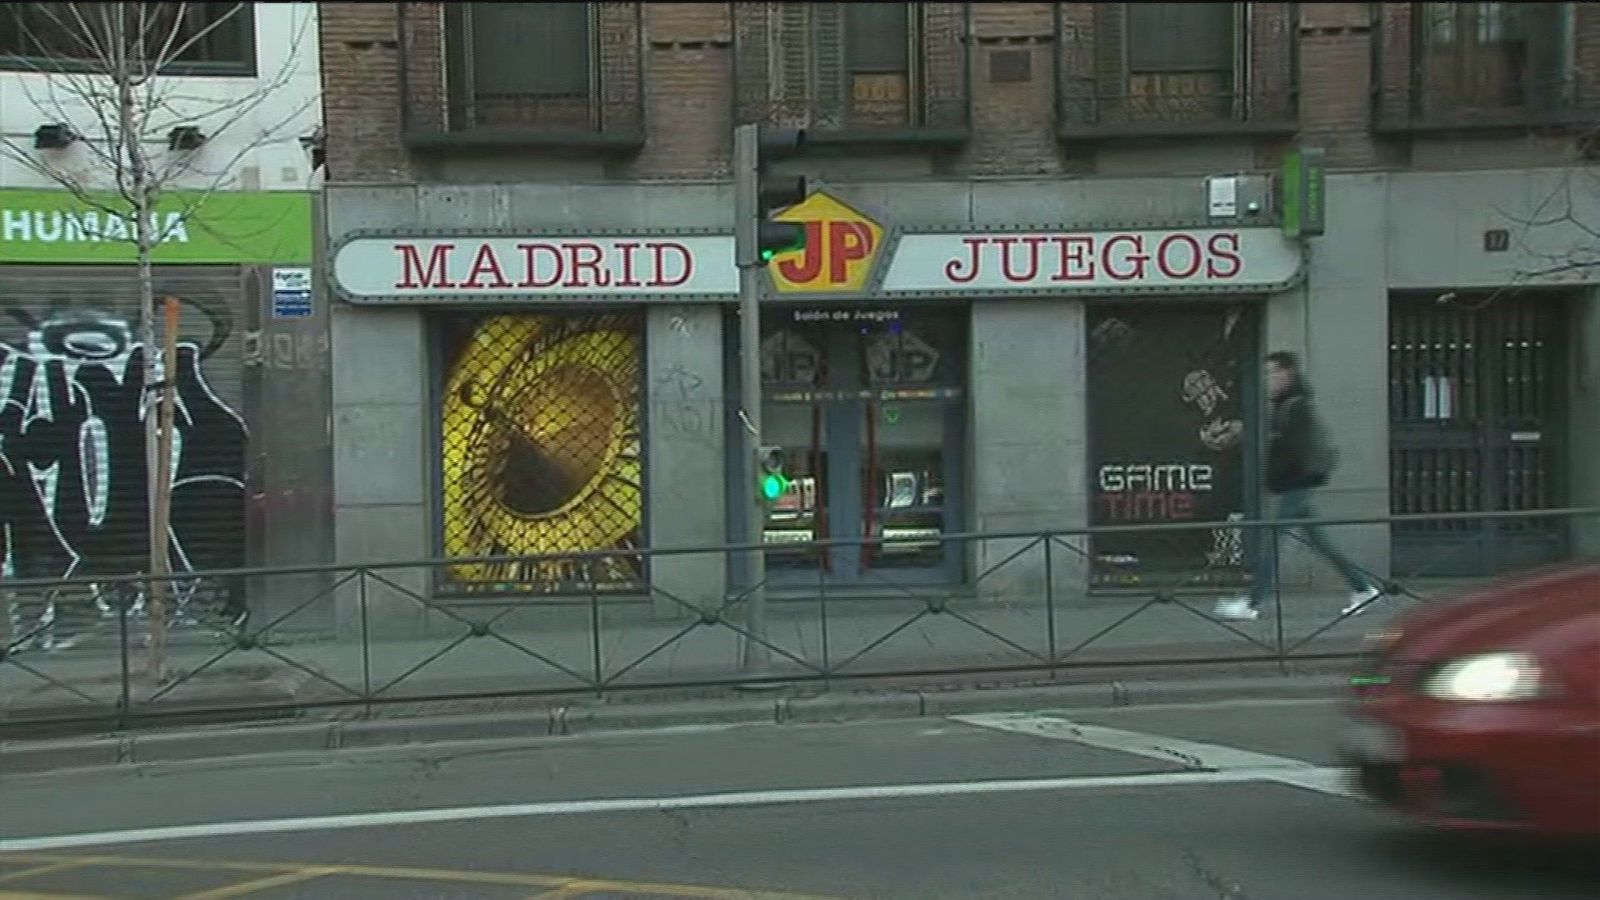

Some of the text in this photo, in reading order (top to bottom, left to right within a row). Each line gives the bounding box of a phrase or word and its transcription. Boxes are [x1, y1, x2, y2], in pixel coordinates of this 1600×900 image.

[4, 209, 190, 243] HUMANA
[778, 220, 873, 284] JP
[394, 233, 1241, 288] MADRID JUEGOS
